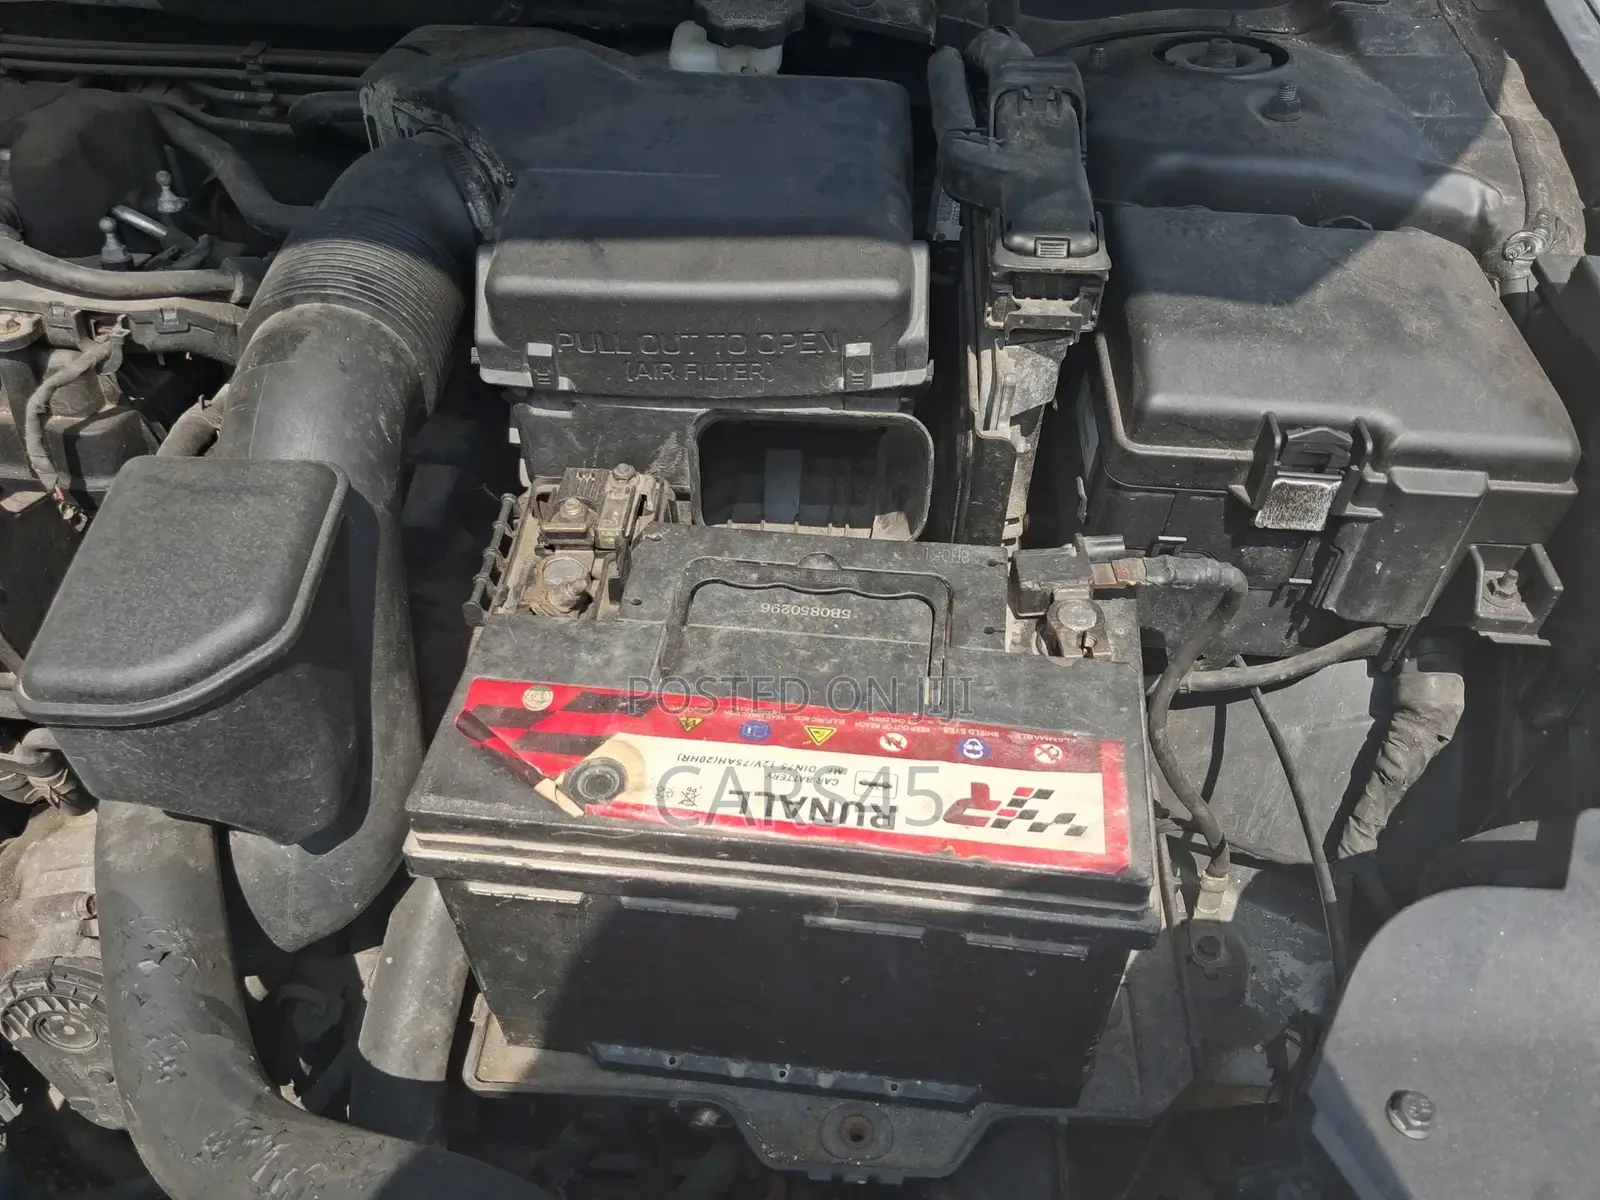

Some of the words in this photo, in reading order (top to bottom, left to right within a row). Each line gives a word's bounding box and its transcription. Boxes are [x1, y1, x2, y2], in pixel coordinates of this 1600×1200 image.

[556, 331, 632, 355] PULL
[640, 333, 699, 355] OUT
[707, 333, 748, 355] TO
[757, 331, 838, 355] OPEN
[625, 360, 678, 382] (AIR
[683, 360, 775, 382] FILTER)
[760, 602, 851, 619] 5B0850296
[894, 723, 909, 731] OUT
[943, 726, 967, 735] EYES
[969, 728, 999, 737] SHIELD
[677, 753, 775, 768] 12V/75AH(20HR)
[780, 762, 817, 773] DIN75
[765, 771, 813, 783] BATTERY
[815, 777, 840, 786] CAR
[729, 790, 899, 830] RUNALL
